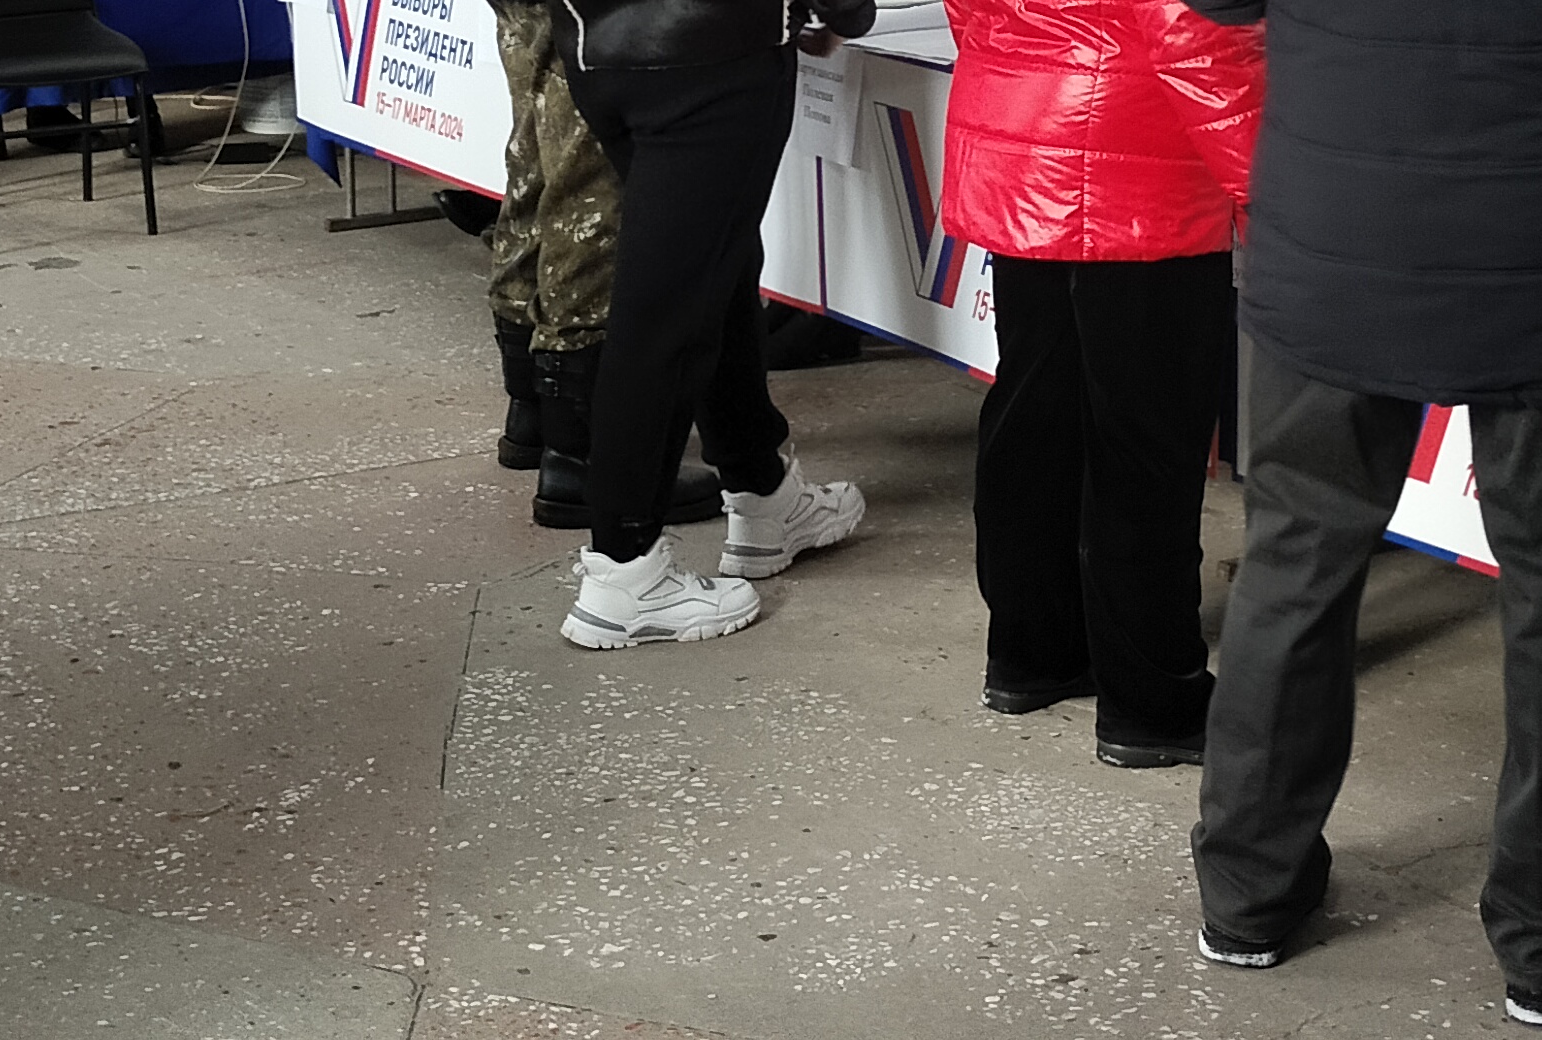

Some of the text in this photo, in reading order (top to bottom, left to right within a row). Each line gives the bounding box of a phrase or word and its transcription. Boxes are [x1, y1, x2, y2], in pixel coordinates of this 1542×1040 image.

[384, 17, 475, 70] ПРЕЗИДЕНТА
[379, 55, 436, 98] РОССИИ
[402, 101, 437, 134] МАРТА
[437, 112, 464, 142] 2024
